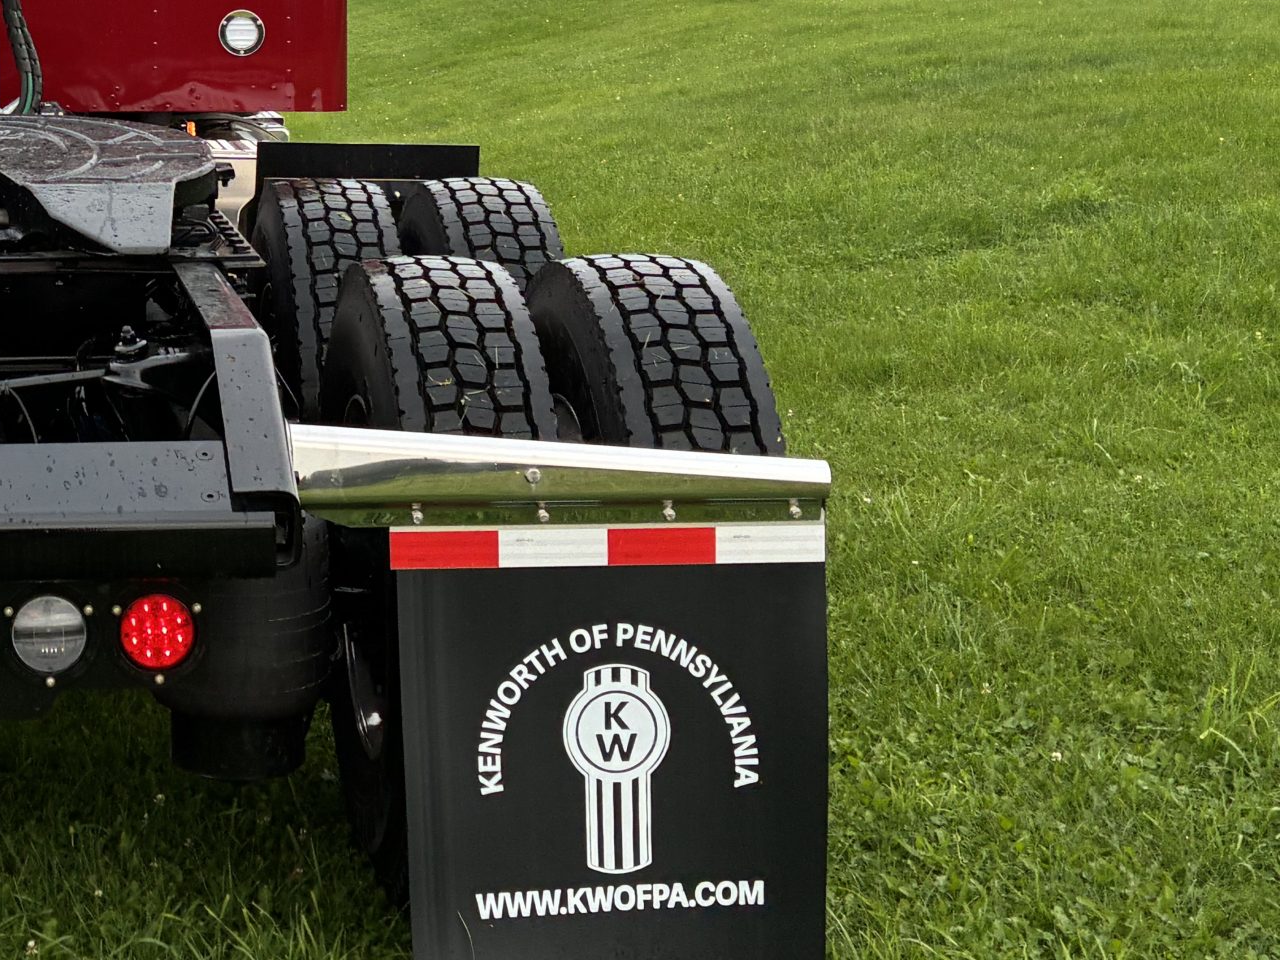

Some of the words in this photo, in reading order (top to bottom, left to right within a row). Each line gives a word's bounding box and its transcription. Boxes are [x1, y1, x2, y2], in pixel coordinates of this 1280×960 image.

[477, 638, 568, 796] KENWORTH
[570, 623, 609, 654] OF
[616, 622, 760, 788] PENNSYLVANIA
[604, 701, 630, 730] K
[595, 733, 637, 762] W
[475, 879, 765, 921] WWW.KWOFPA.COM
